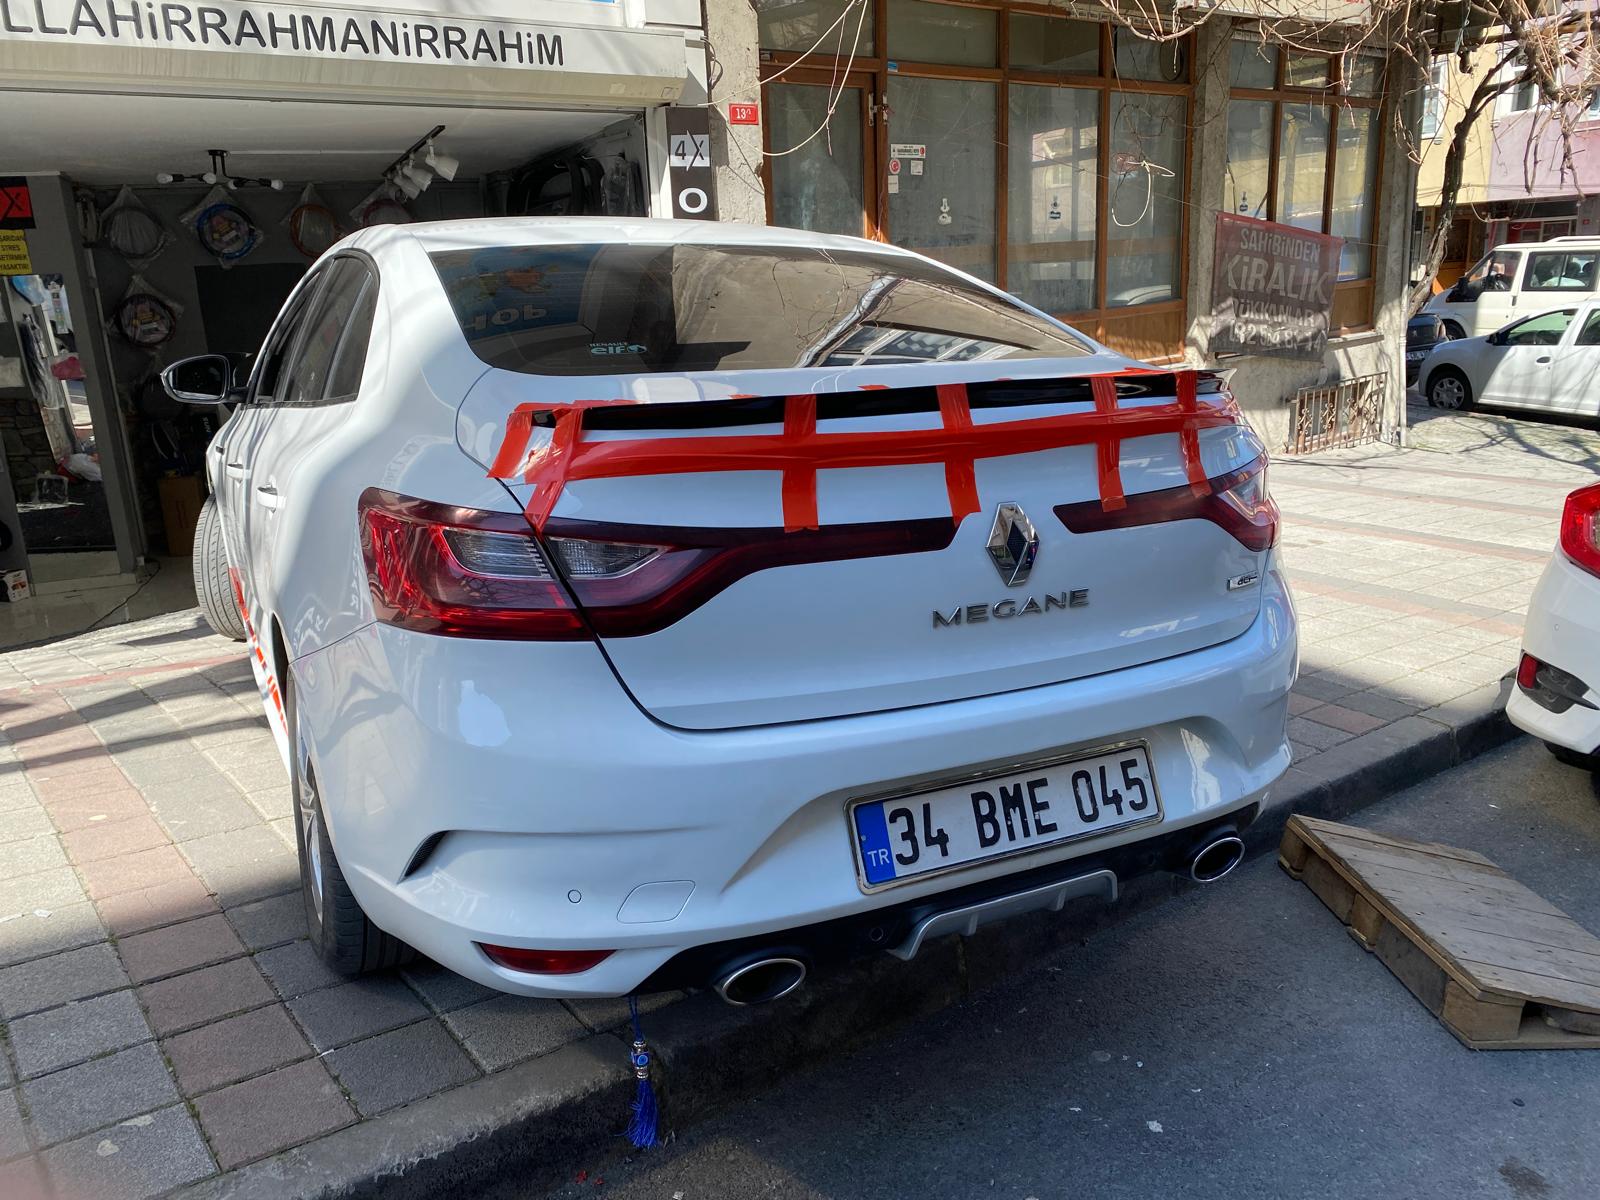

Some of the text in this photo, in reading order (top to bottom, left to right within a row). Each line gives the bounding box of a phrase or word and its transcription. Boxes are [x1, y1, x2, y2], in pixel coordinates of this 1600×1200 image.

[678, 187, 708, 214] O
[932, 587, 1090, 628] MEGANE
[888, 758, 1149, 866] 34 BME 045
[867, 847, 891, 868] TR
